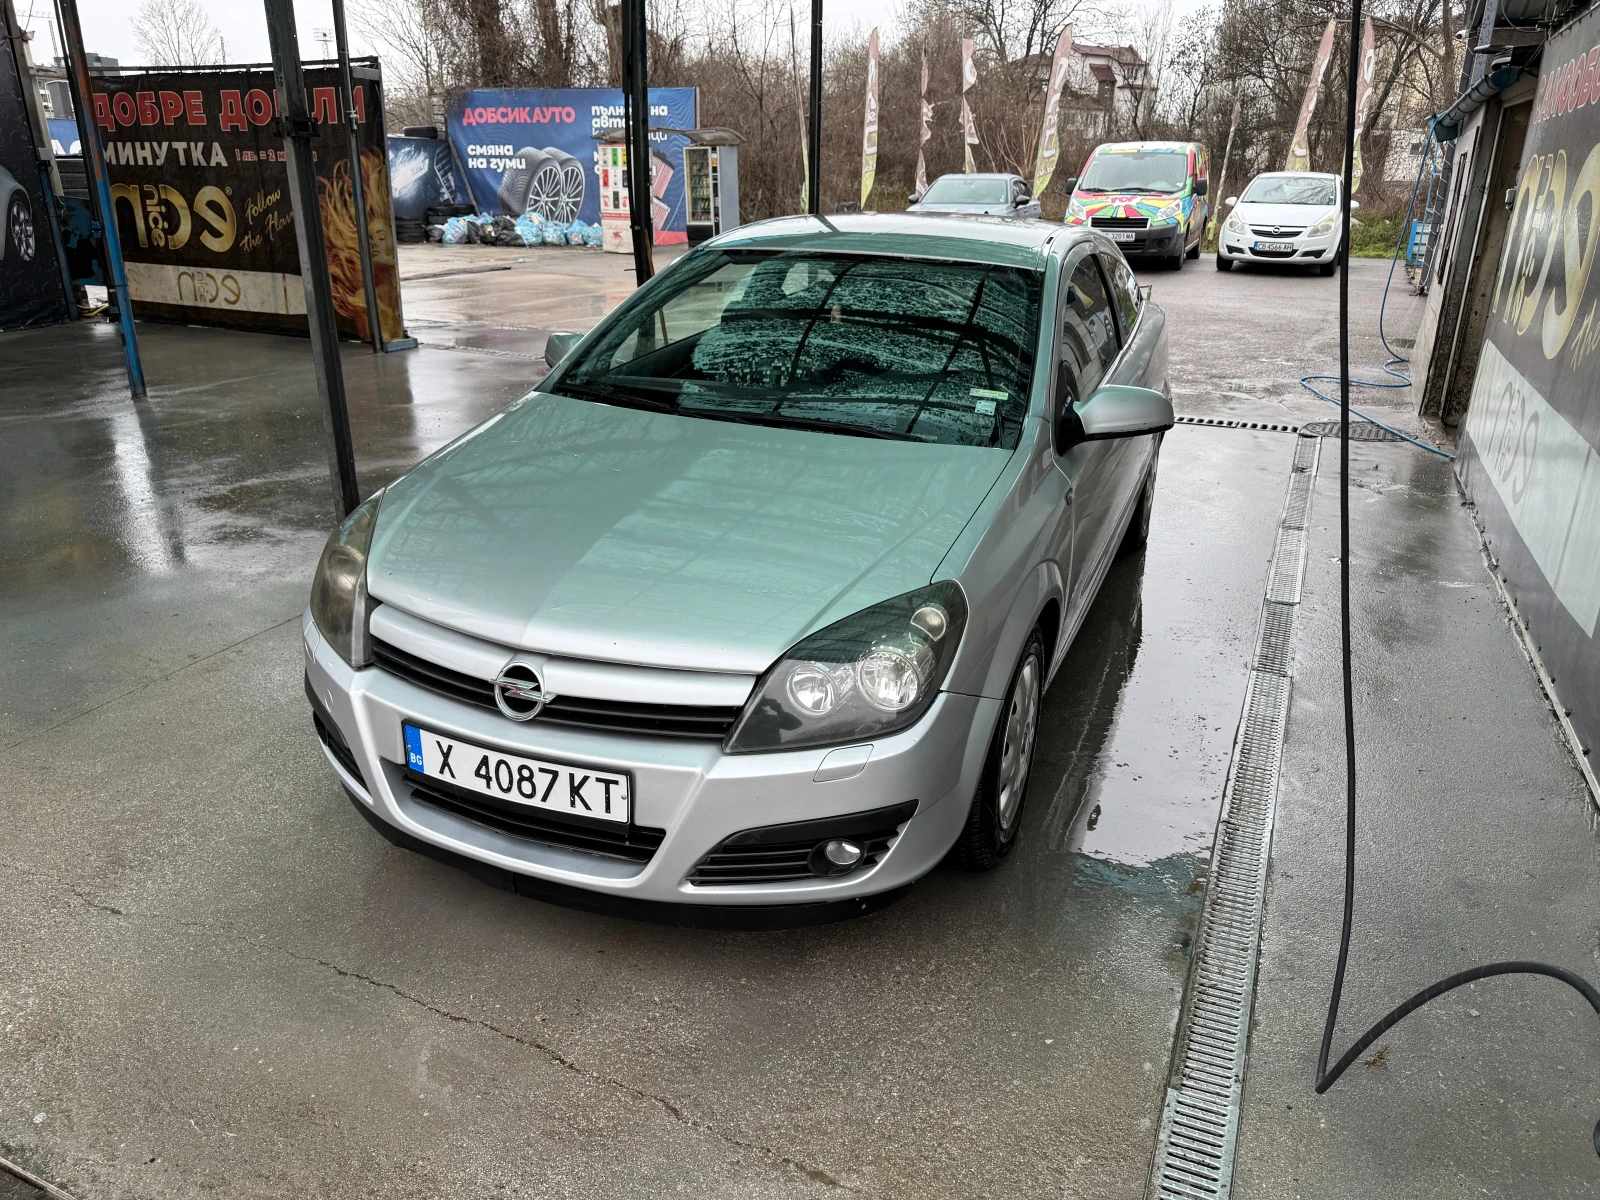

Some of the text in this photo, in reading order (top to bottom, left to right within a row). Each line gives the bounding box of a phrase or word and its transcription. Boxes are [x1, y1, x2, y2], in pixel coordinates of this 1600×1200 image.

[93, 90, 207, 132] ДОБРЕ
[462, 106, 576, 126] ДОБСИК АУТО
[102, 141, 229, 167] МИНУТКА
[268, 149, 276, 161] 2
[467, 144, 514, 156] смяна
[468, 158, 527, 173] на гуми
[245, 189, 281, 225] Follow
[410, 752, 422, 766] BG
[435, 740, 619, 814] X 4087 KT
